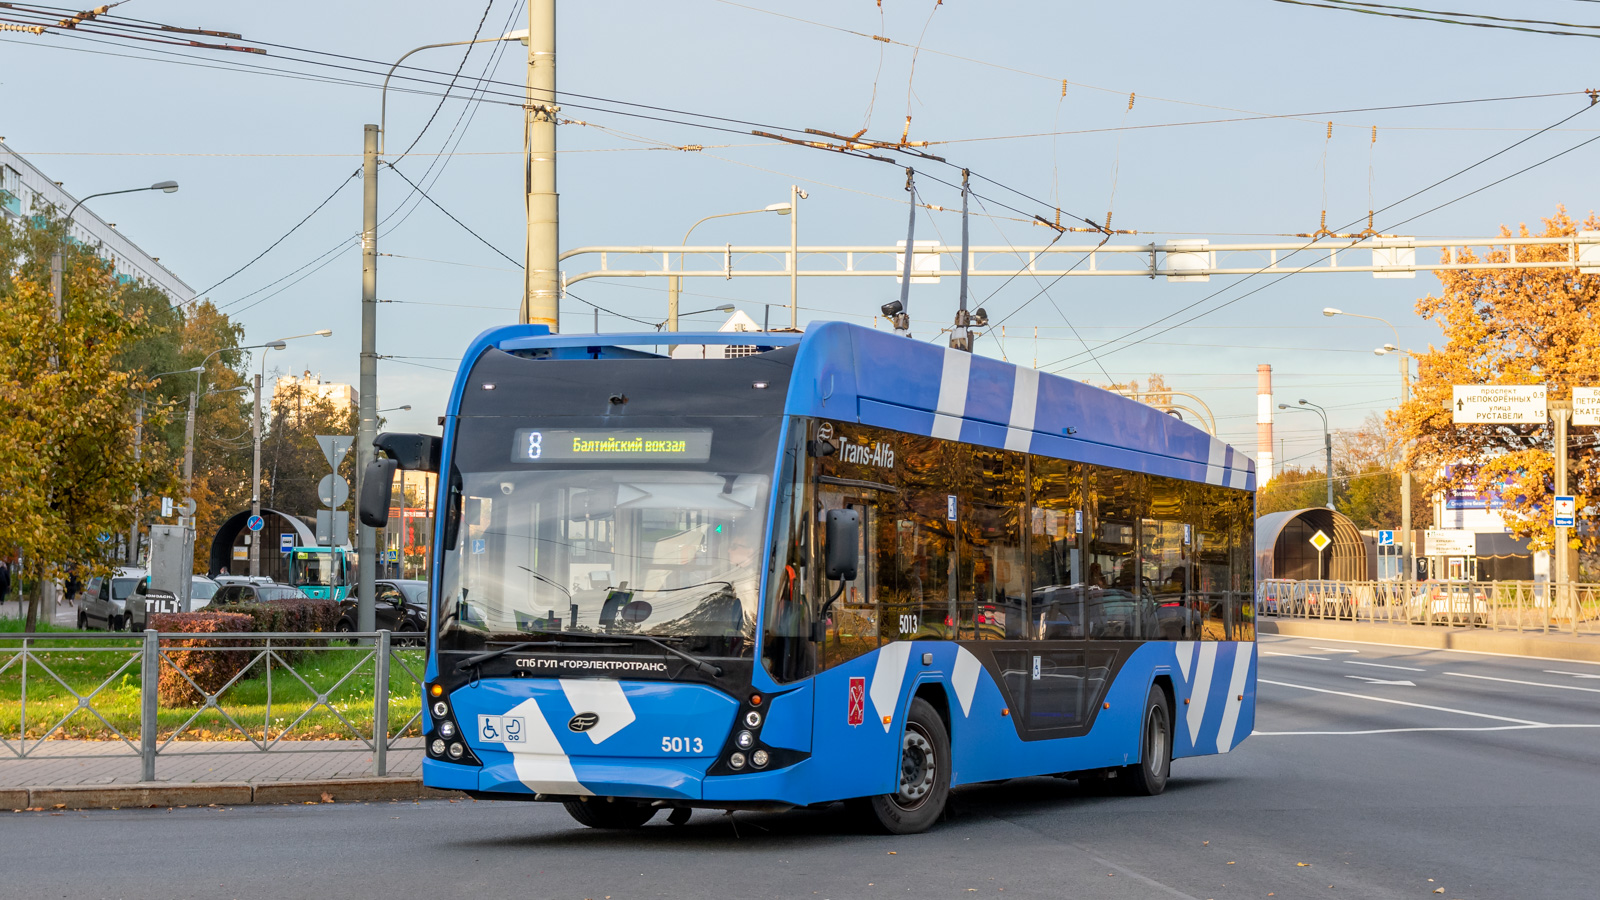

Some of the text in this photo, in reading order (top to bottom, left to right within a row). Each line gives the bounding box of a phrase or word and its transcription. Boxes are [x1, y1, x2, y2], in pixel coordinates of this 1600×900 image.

[1476, 412, 1524, 420] РУСТАВЕЛИ
[528, 431, 542, 459] 8
[572, 437, 686, 453] Балтийский вокзал
[839, 436, 894, 469] Trans-Alfa
[899, 614, 918, 634] 5013
[537, 659, 558, 669] ГУП
[661, 736, 704, 754] 5013
